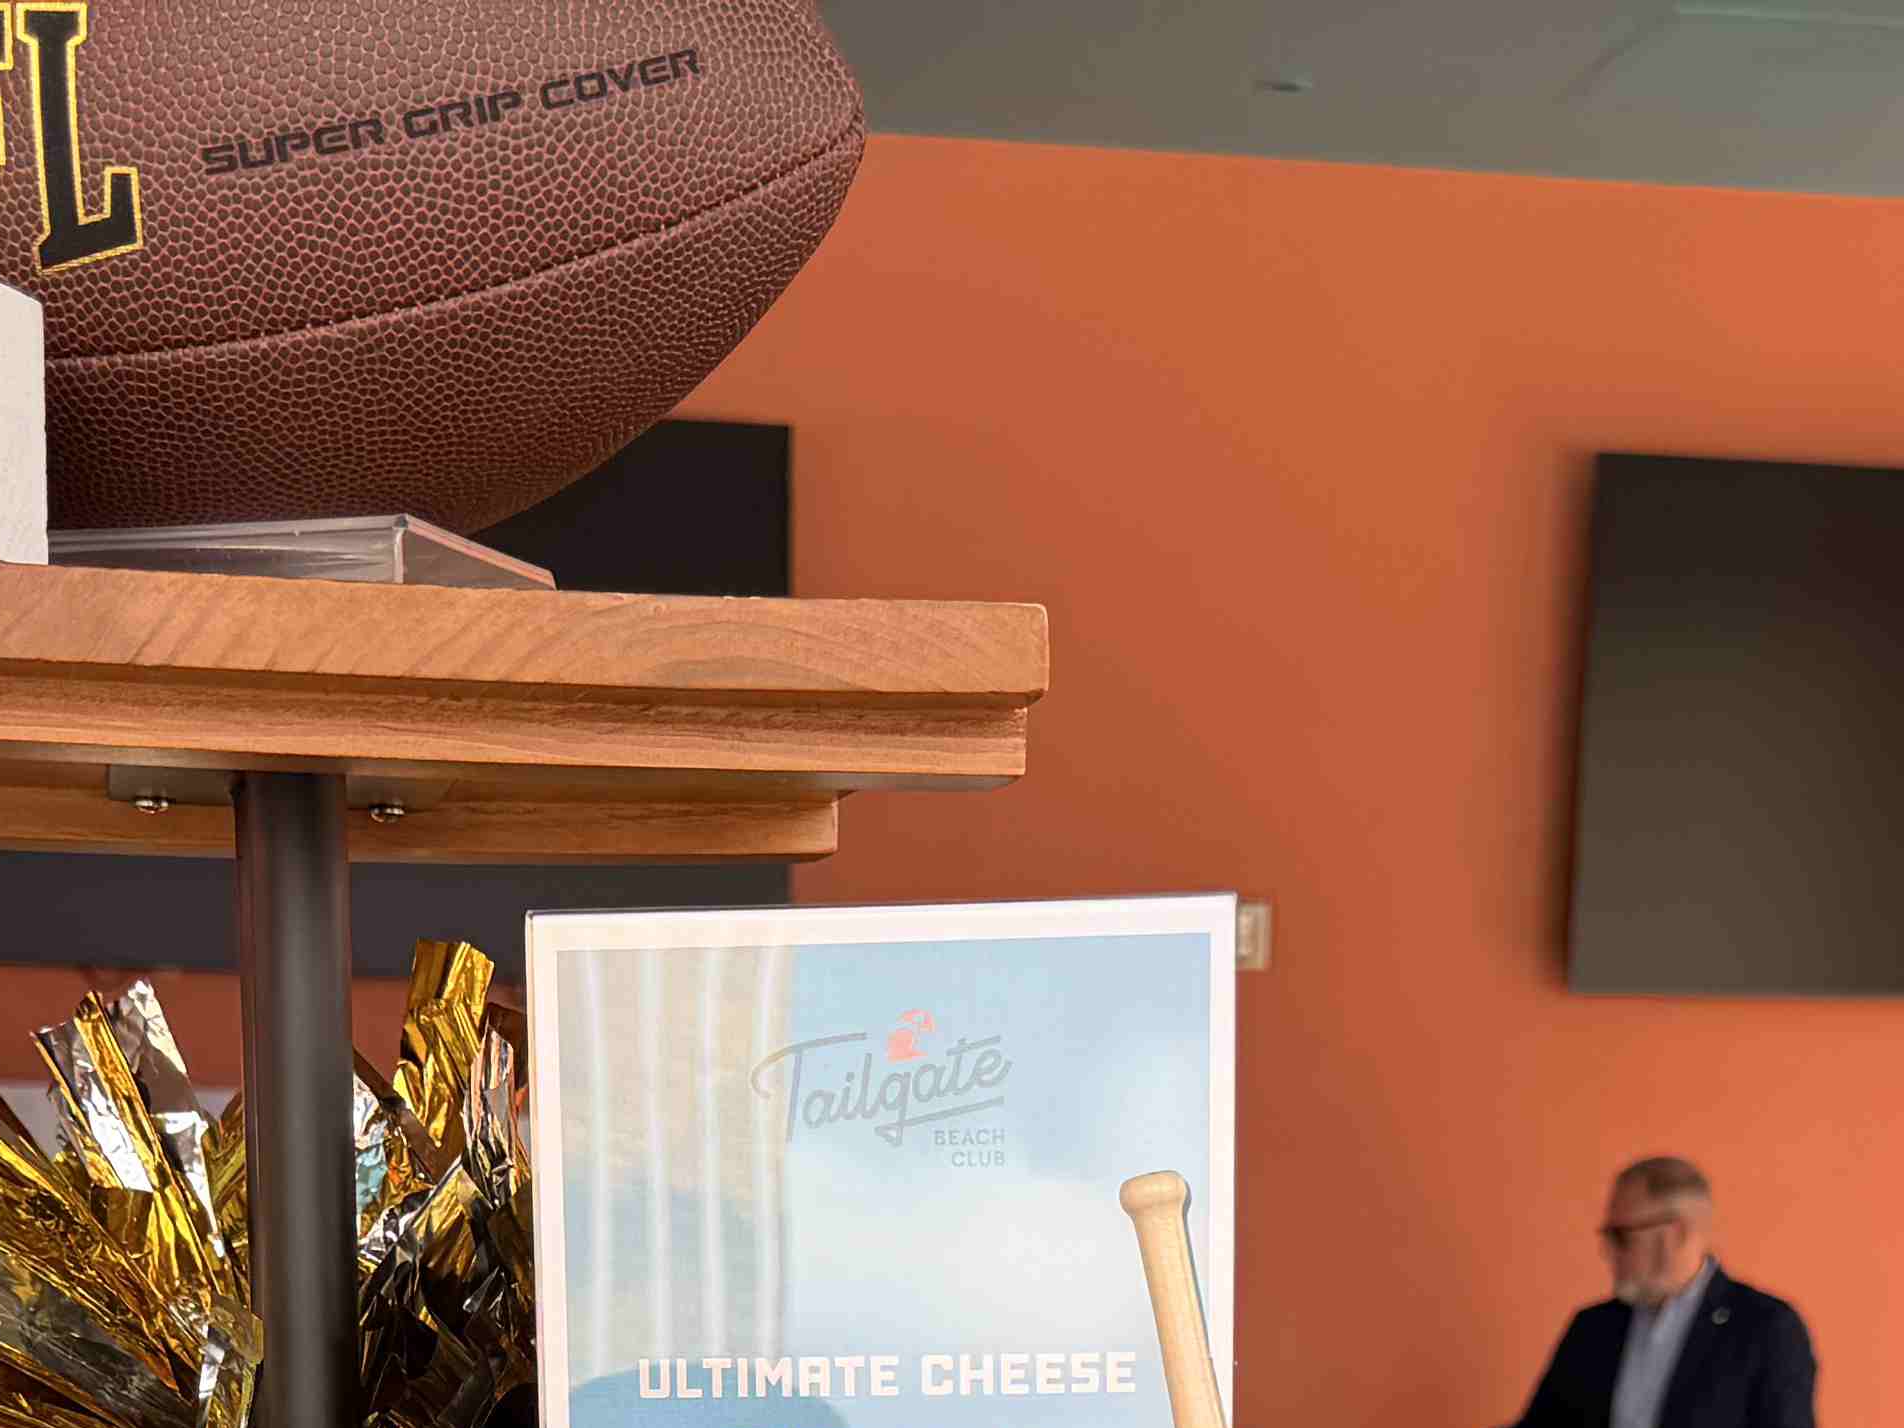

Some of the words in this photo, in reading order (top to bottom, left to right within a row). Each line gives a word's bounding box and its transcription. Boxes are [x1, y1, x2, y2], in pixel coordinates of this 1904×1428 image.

[201, 115, 393, 178] SUPER
[402, 87, 528, 145] GRIP
[538, 49, 701, 116] COVER
[751, 1032, 1013, 1147] Tailgate
[934, 1129, 1005, 1147] BEACH
[951, 1150, 1005, 1168] CLUB
[638, 1355, 899, 1400] ULTIMATE
[921, 1351, 1137, 1396] CHEESE
